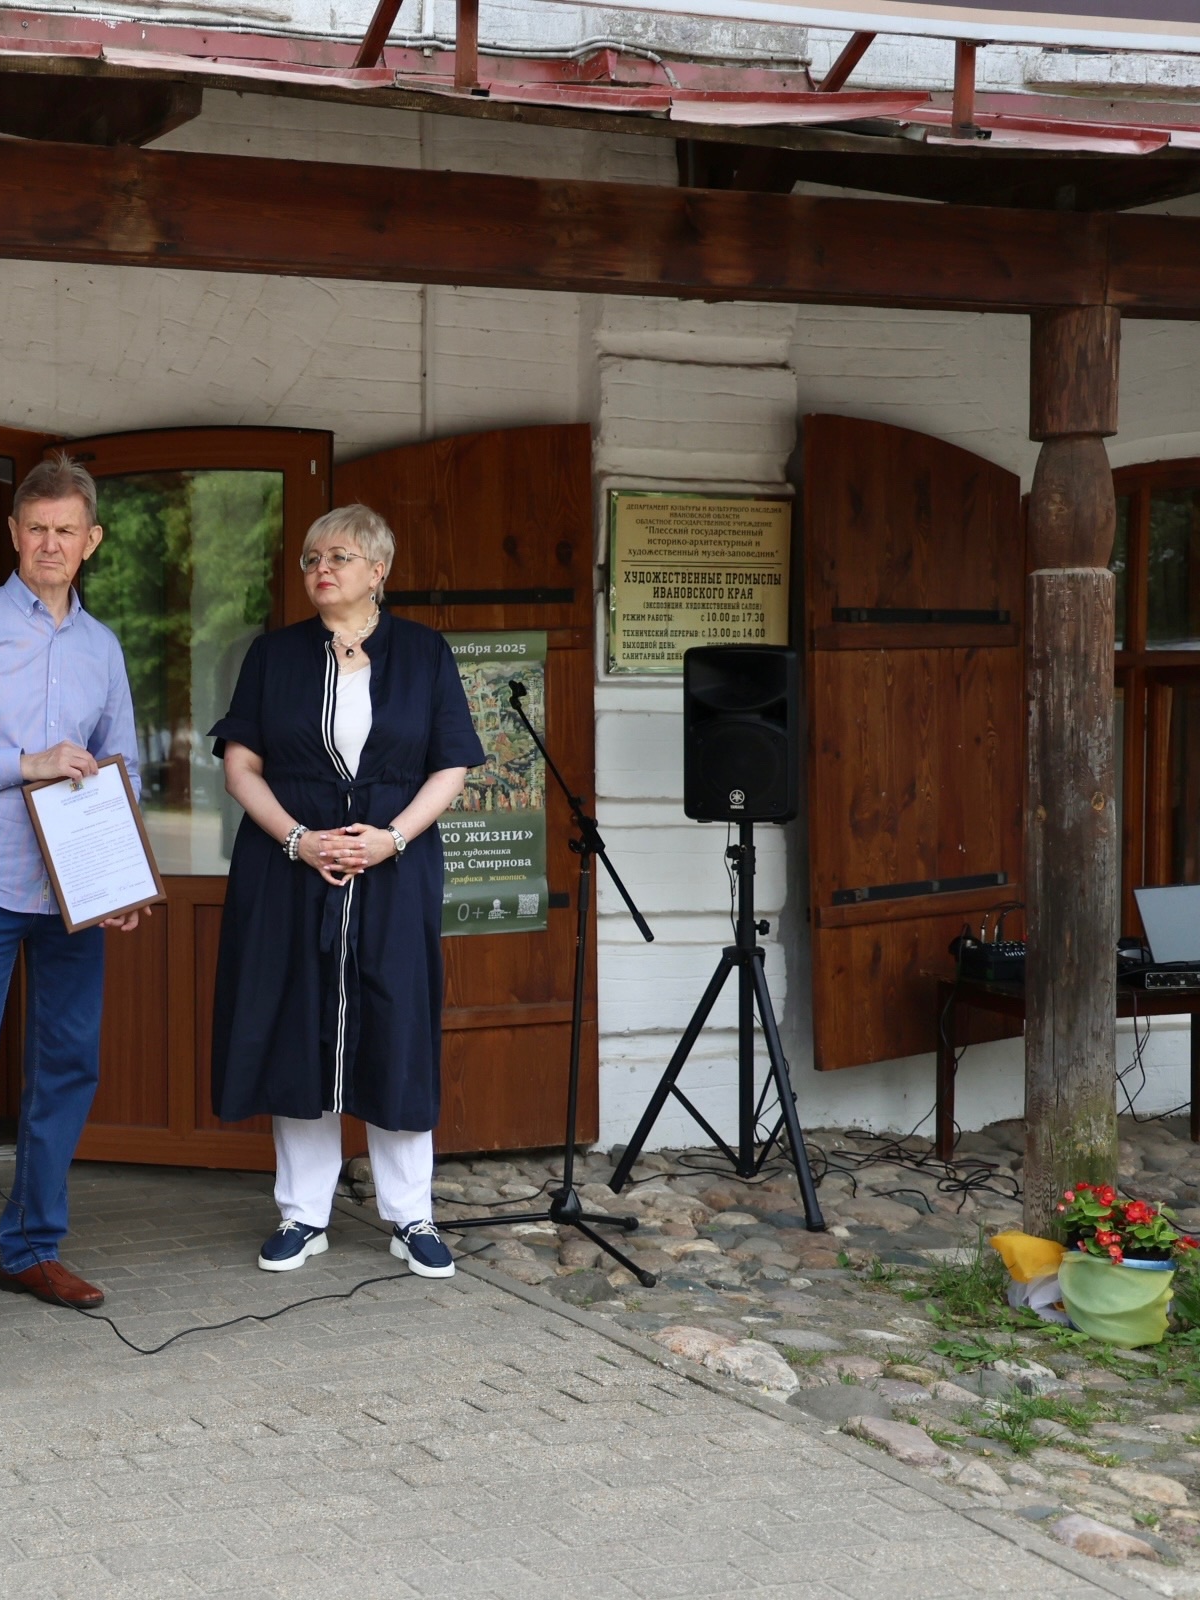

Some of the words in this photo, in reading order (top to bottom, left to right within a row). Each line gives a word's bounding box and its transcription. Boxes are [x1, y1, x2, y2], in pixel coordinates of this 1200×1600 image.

[690, 527, 763, 537] государственный
[647, 537, 752, 548] историко-архитектурный
[628, 548, 698, 557] художественный
[624, 571, 722, 584] ХУДОЖЕСТВЕННЫЕ
[725, 572, 782, 585] ПРОМЫСЛЫ
[653, 586, 724, 599] ИВАНОВСКОГО
[727, 587, 753, 600] КРАЯ
[685, 601, 740, 610] ХУДОЖЕСТВЕННЫЙ
[741, 602, 762, 611] САЛОН)
[622, 613, 646, 622] РЕЖИМ
[647, 613, 674, 622] РАБОТЫ:
[706, 612, 730, 622] 10.00
[731, 615, 740, 623] до
[742, 612, 765, 622] 17.30
[622, 628, 668, 638] ТЕХНИЧЕСКИЙ
[669, 629, 700, 638] ПЕРЕРЫВ:
[707, 628, 731, 638] 13.00
[732, 630, 741, 639] до
[742, 628, 766, 638] 14.00
[451, 643, 491, 656] оября
[495, 644, 527, 654] 2025
[622, 640, 657, 649] ВЫХОДНОЙ
[658, 641, 676, 650] ДЕНЬ:
[622, 651, 665, 660] САНИТАРНЫЙ
[464, 830, 534, 842] жизни»
[462, 848, 511, 857] художника
[467, 858, 532, 870] Смирнова
[450, 875, 483, 884] графика
[488, 874, 527, 882] живопись
[457, 903, 484, 922] 0+
